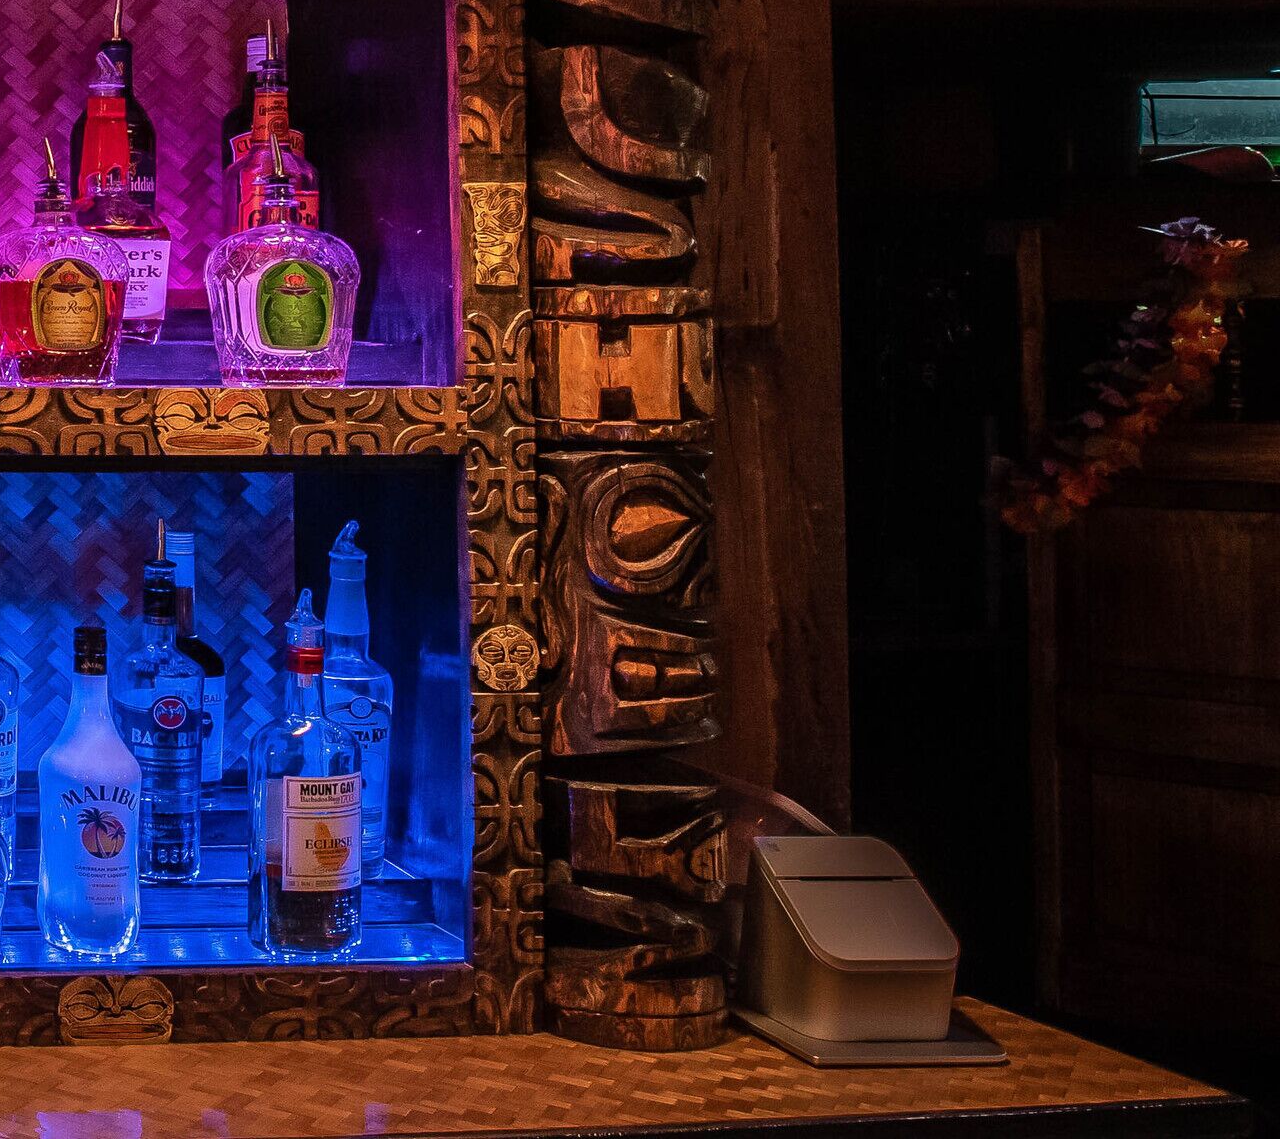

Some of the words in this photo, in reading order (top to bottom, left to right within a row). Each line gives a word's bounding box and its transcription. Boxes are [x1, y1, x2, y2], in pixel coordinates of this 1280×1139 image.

[65, 300, 93, 315] Royal
[300, 782, 338, 796] MOUNT
[340, 780, 356, 794] GAY
[60, 784, 139, 812] MALIBU
[304, 836, 353, 850] ECLIPSE
